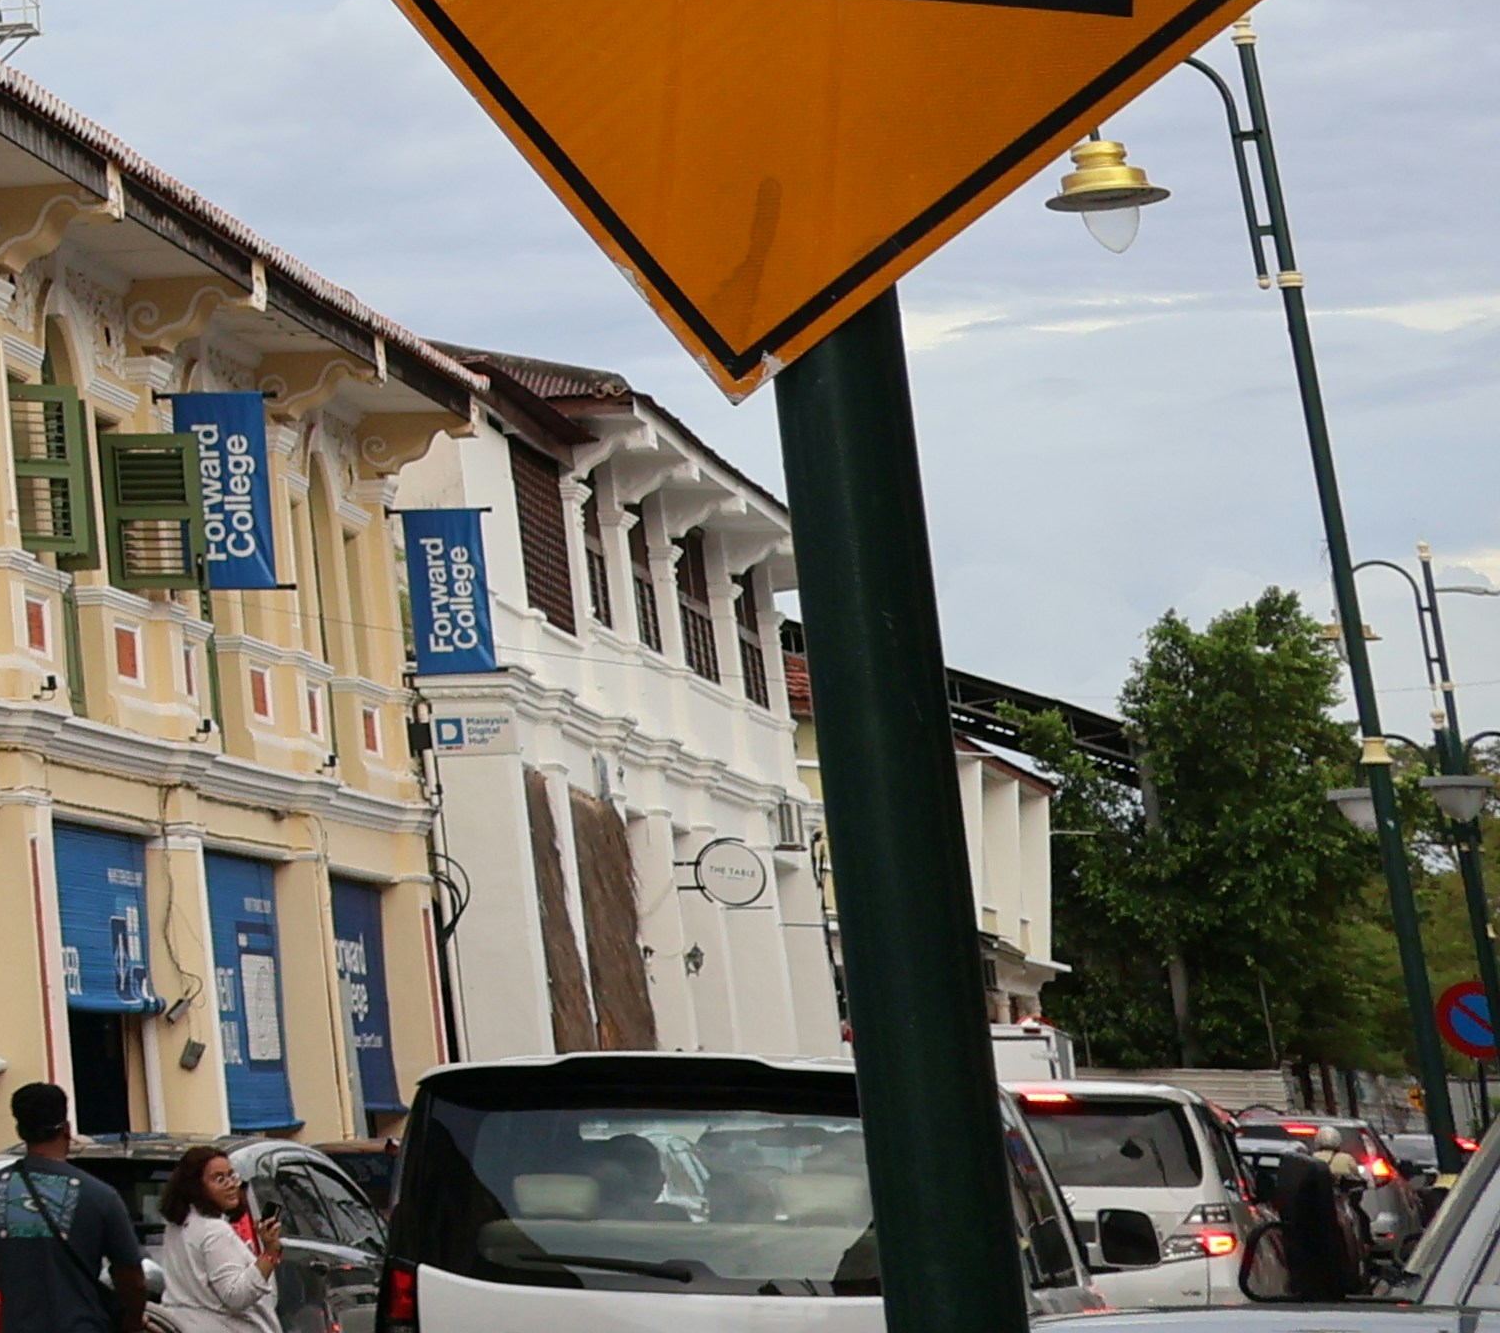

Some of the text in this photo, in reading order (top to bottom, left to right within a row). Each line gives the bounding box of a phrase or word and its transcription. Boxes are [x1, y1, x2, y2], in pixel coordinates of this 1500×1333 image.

[224, 434, 256, 557] College
[419, 538, 455, 653] Forward
[449, 546, 478, 649] College
